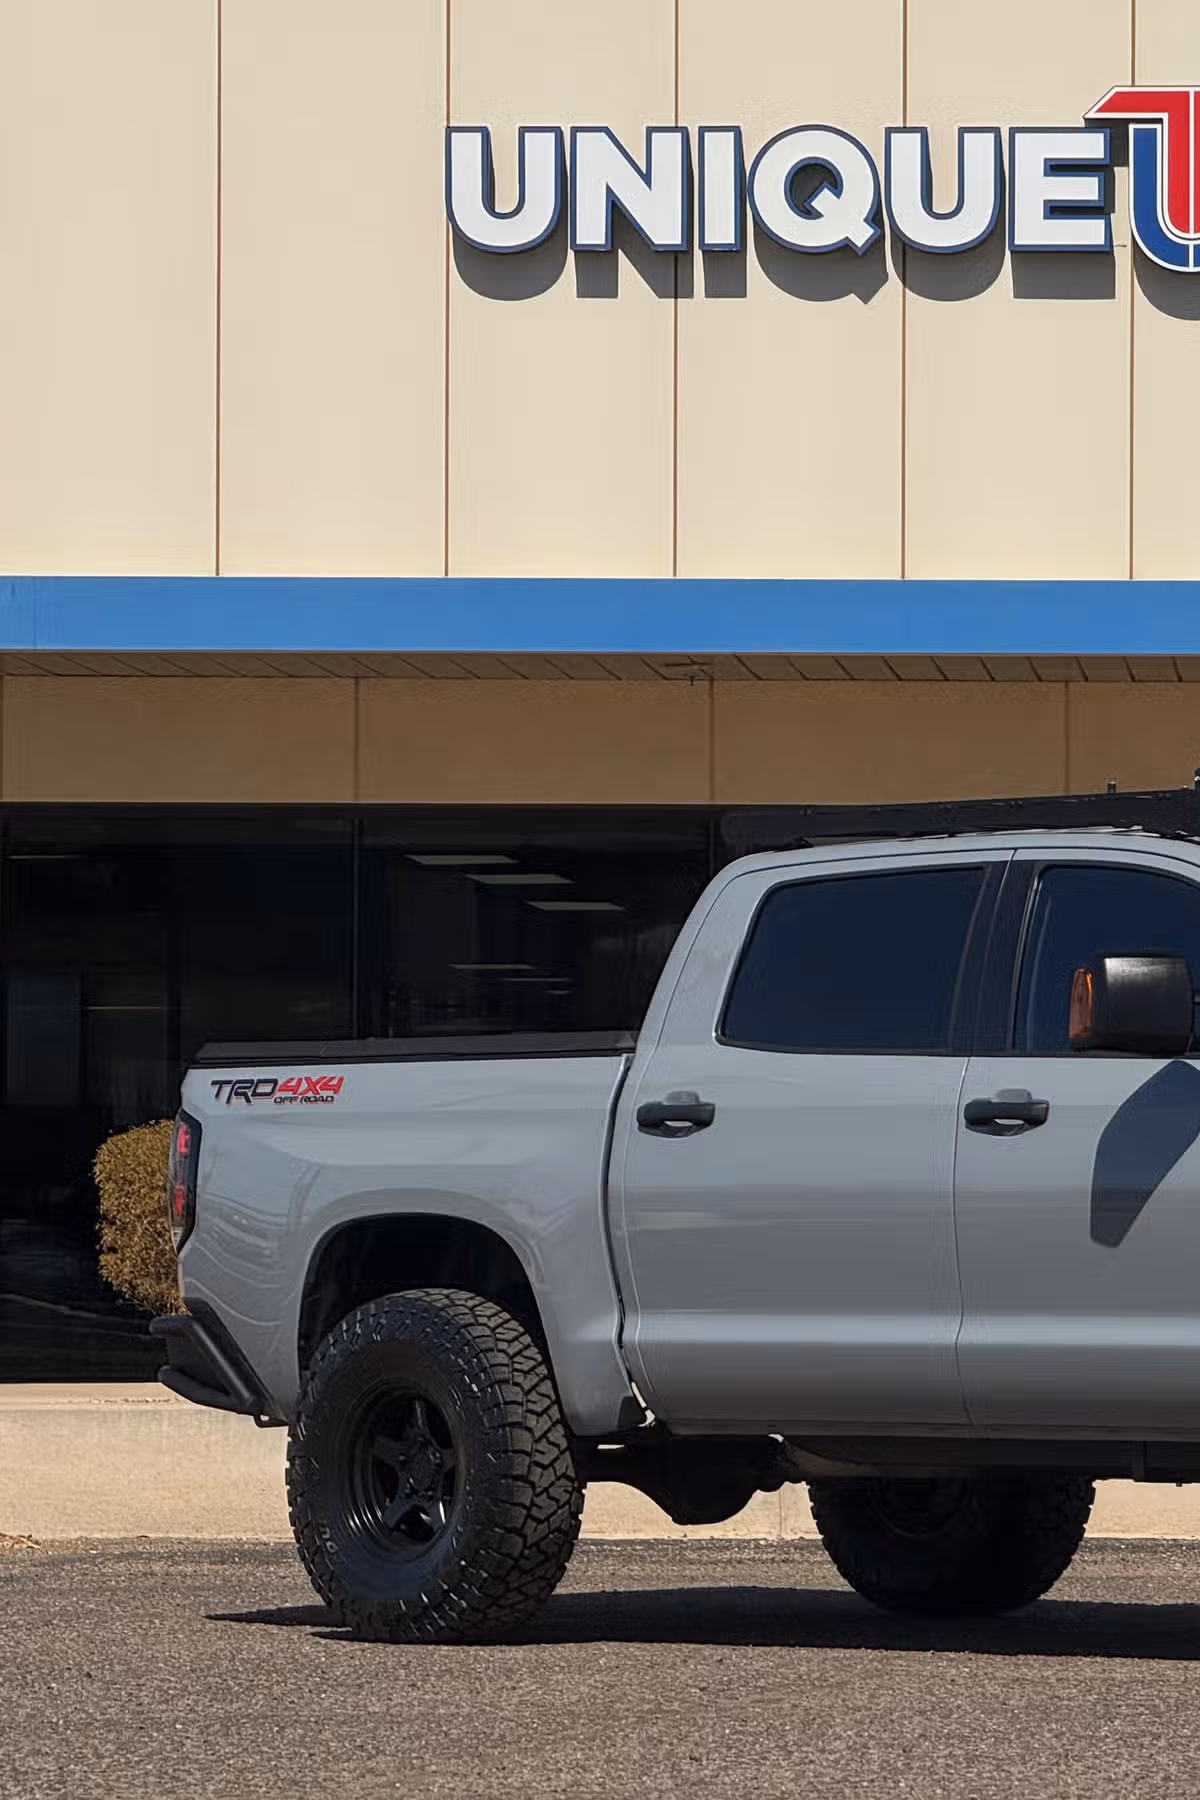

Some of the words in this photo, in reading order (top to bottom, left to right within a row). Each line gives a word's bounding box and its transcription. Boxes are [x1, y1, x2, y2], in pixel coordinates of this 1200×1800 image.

[445, 124, 1113, 256] UNIQUE
[211, 1078, 278, 1105] TRD
[273, 1096, 298, 1104] OFF
[299, 1095, 335, 1104] ROAD
